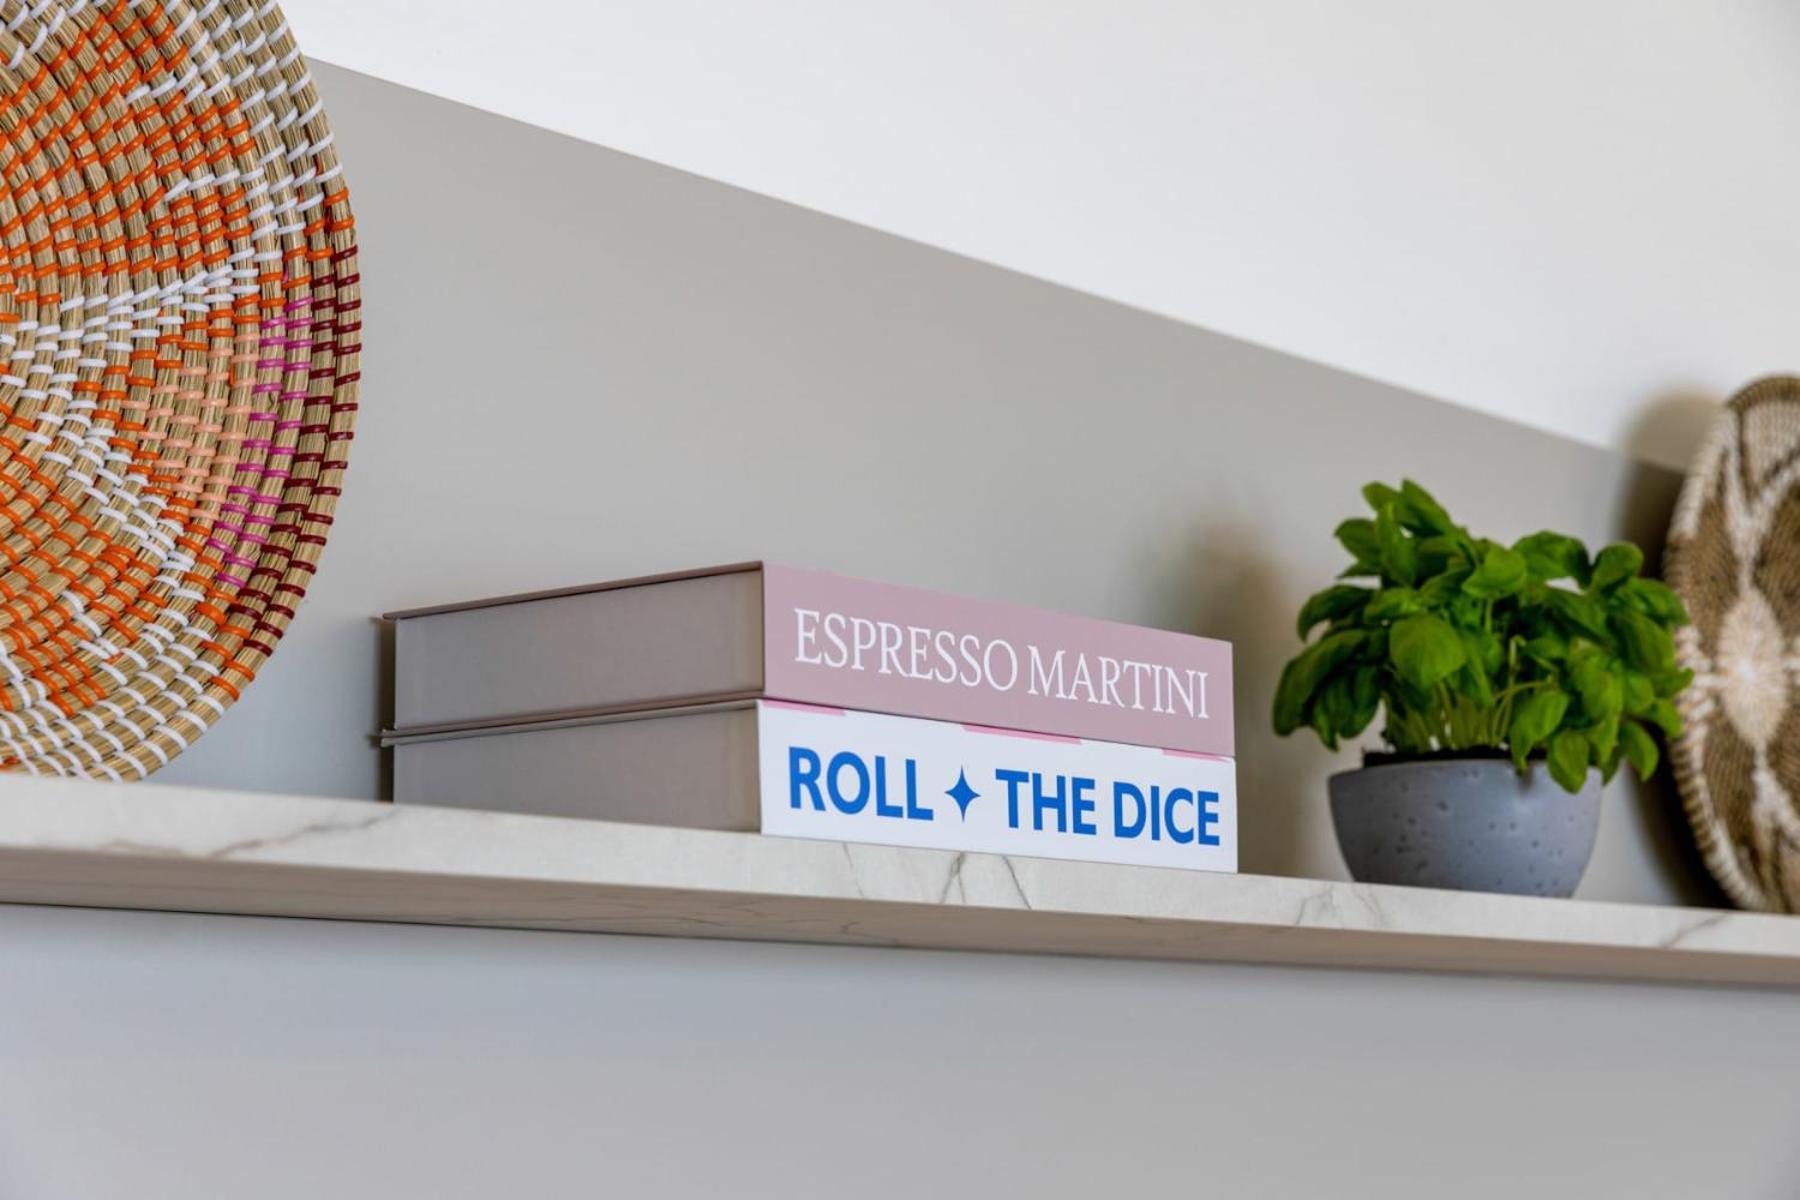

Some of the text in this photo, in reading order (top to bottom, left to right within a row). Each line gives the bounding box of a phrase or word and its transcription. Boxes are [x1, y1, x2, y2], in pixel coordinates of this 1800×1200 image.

[794, 608, 1209, 719] ESPRESSO MARTINI
[788, 746, 1220, 846] ROLL THE DICE
